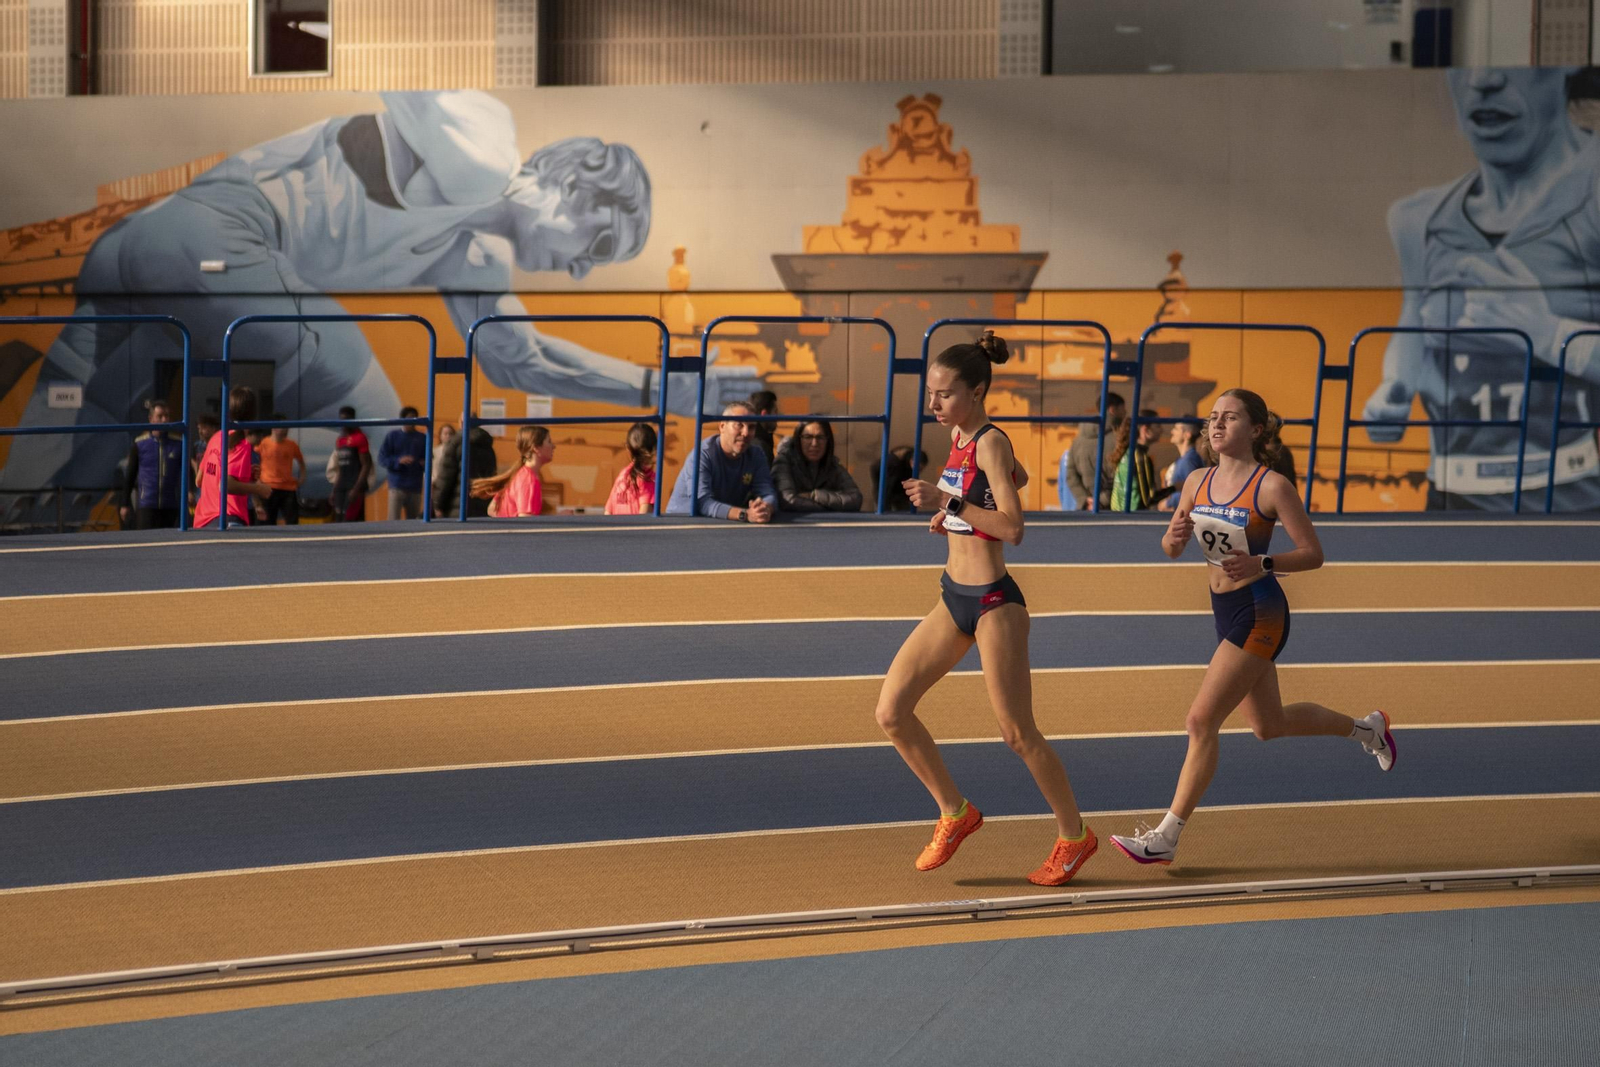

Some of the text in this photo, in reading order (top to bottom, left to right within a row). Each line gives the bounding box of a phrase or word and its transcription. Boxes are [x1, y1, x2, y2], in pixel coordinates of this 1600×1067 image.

[1470, 383, 1525, 422] 17
[1224, 508, 1246, 518] 2026
[1201, 530, 1232, 554] 93
